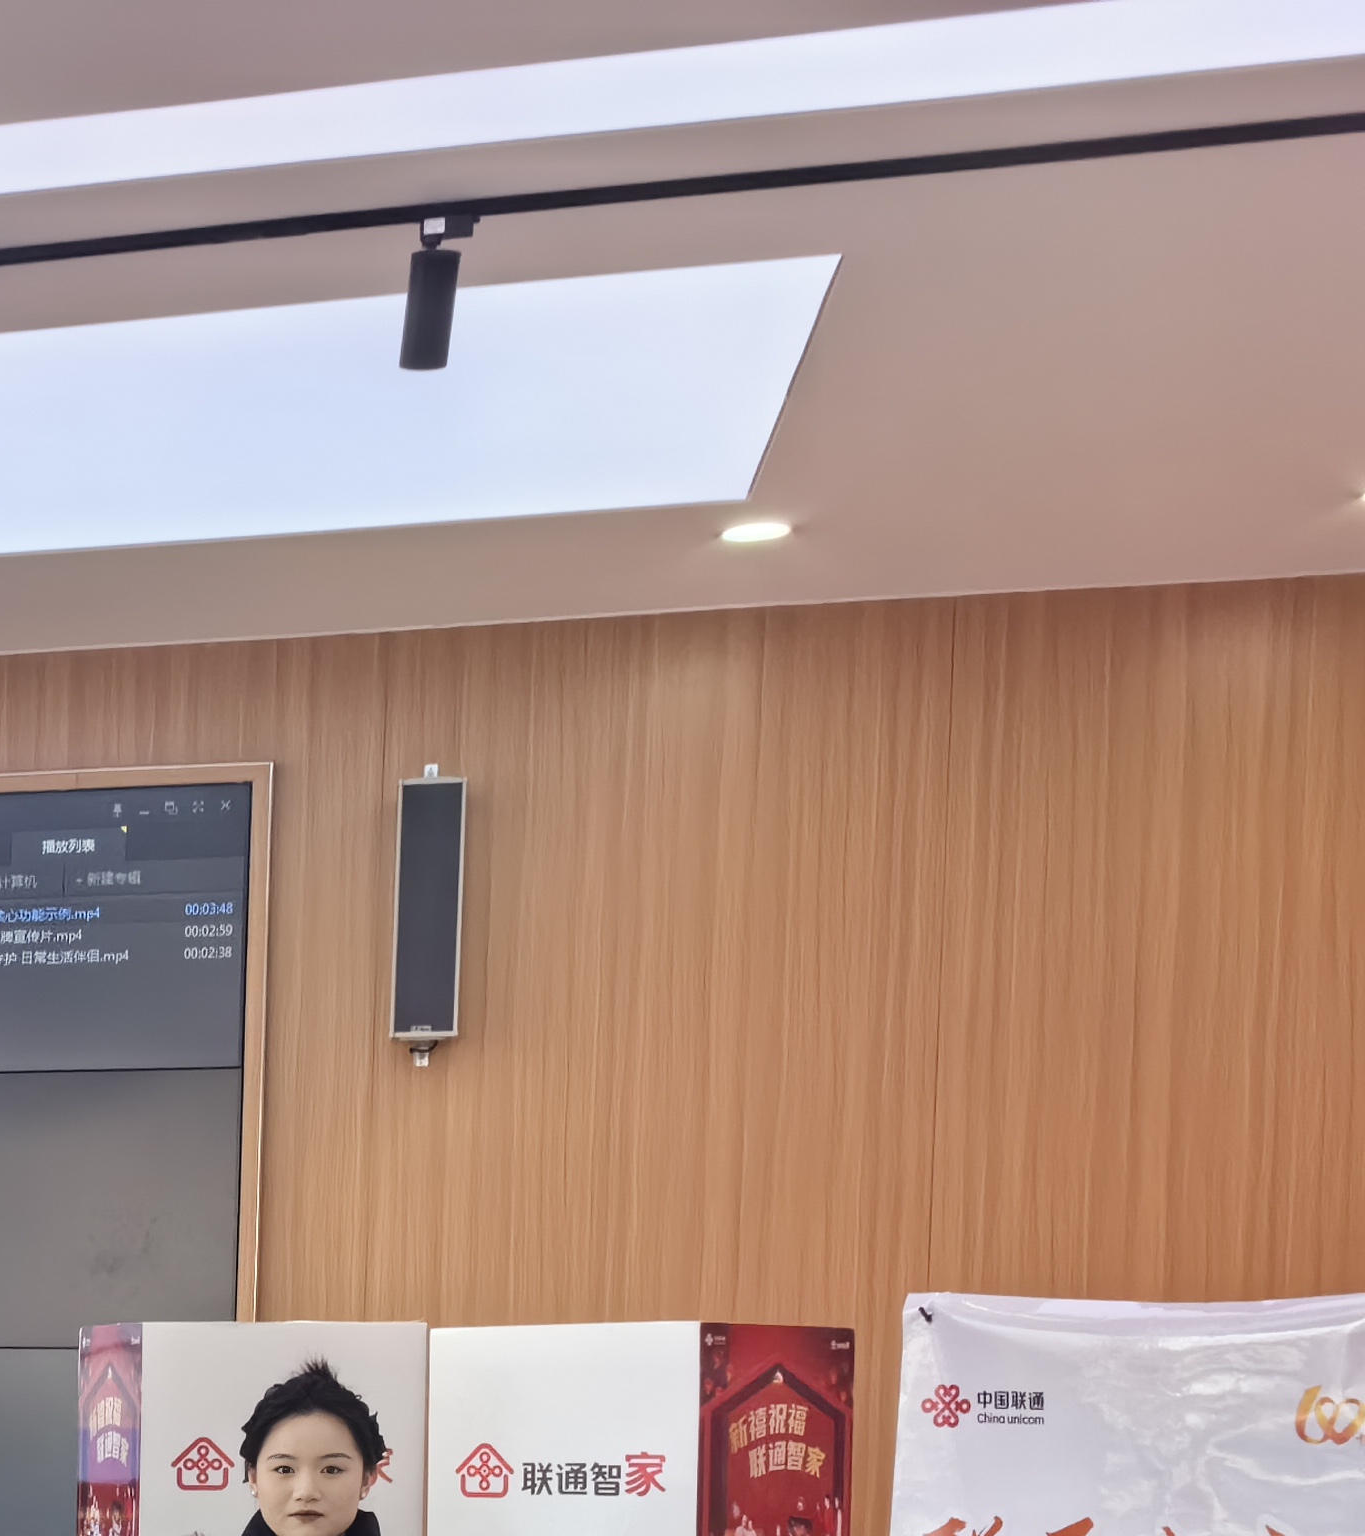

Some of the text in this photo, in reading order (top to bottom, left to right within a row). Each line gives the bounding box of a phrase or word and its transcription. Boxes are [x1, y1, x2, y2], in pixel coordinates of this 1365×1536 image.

[42, 838, 96, 855] 播放列表
[87, 870, 142, 886] 新建专辑
[185, 902, 234, 916] 00:03:48
[184, 925, 234, 938] 00:02:59
[183, 947, 233, 961] 00:02:38
[976, 1389, 1045, 1411] 中国联通
[976, 1412, 1005, 1426] China
[729, 1403, 810, 1455] 新禧祝福
[748, 1440, 827, 1479] 联通智家
[521, 1451, 667, 1498] 联通智家
